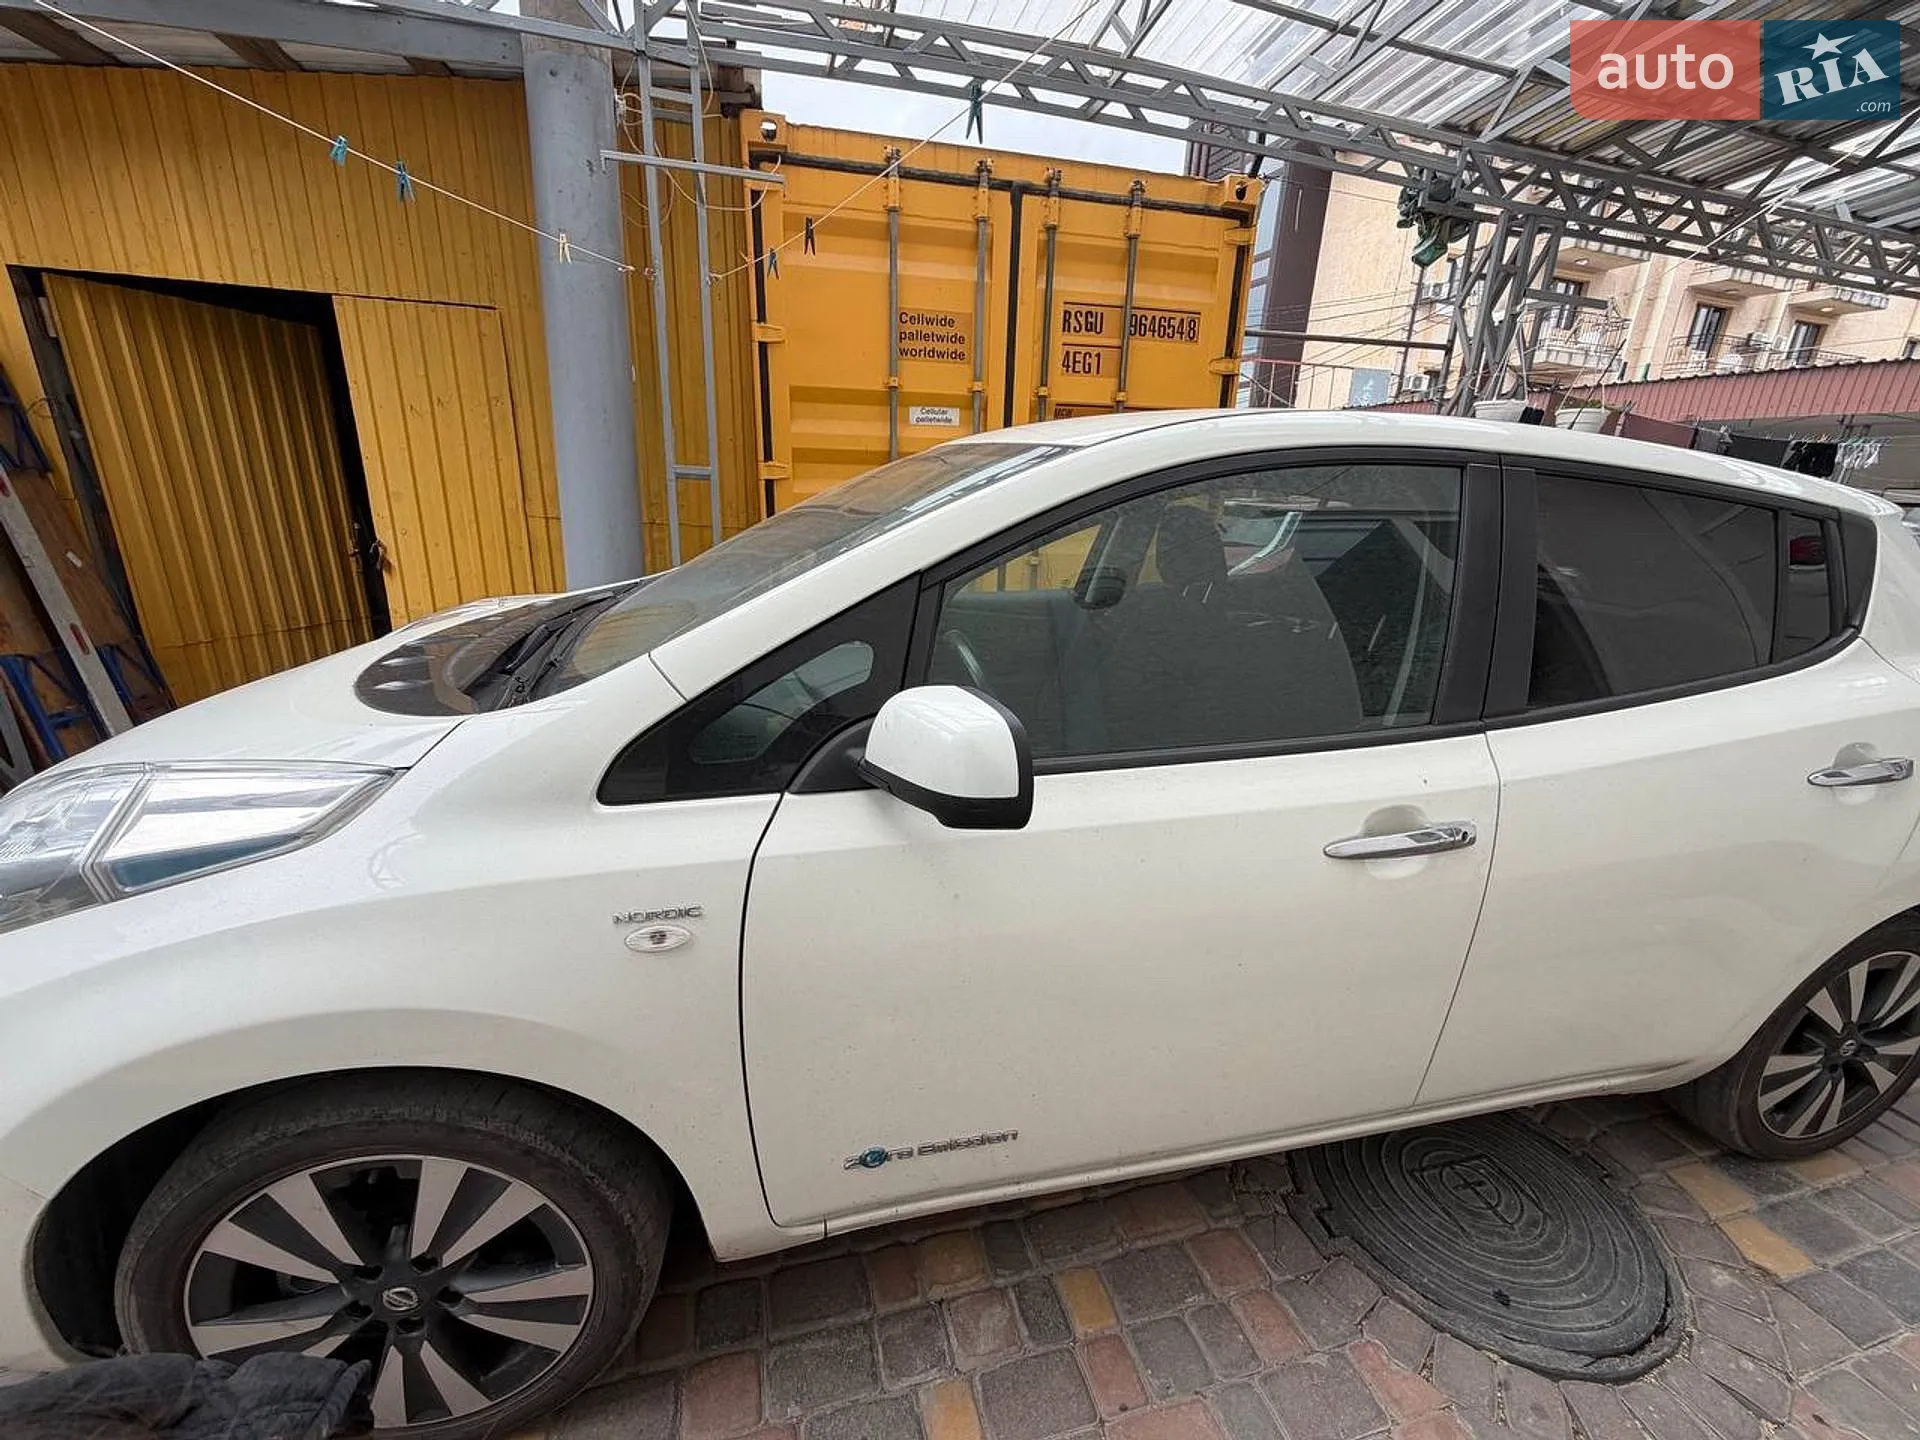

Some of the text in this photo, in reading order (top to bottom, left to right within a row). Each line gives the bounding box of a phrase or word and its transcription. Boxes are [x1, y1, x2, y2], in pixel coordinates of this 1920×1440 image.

[899, 312, 955, 328] Cellwide
[1062, 310, 1198, 341] RSGU 9646548
[899, 329, 966, 345] palletwide
[899, 347, 966, 361] worldwide
[1062, 350, 1101, 375] 4EG1
